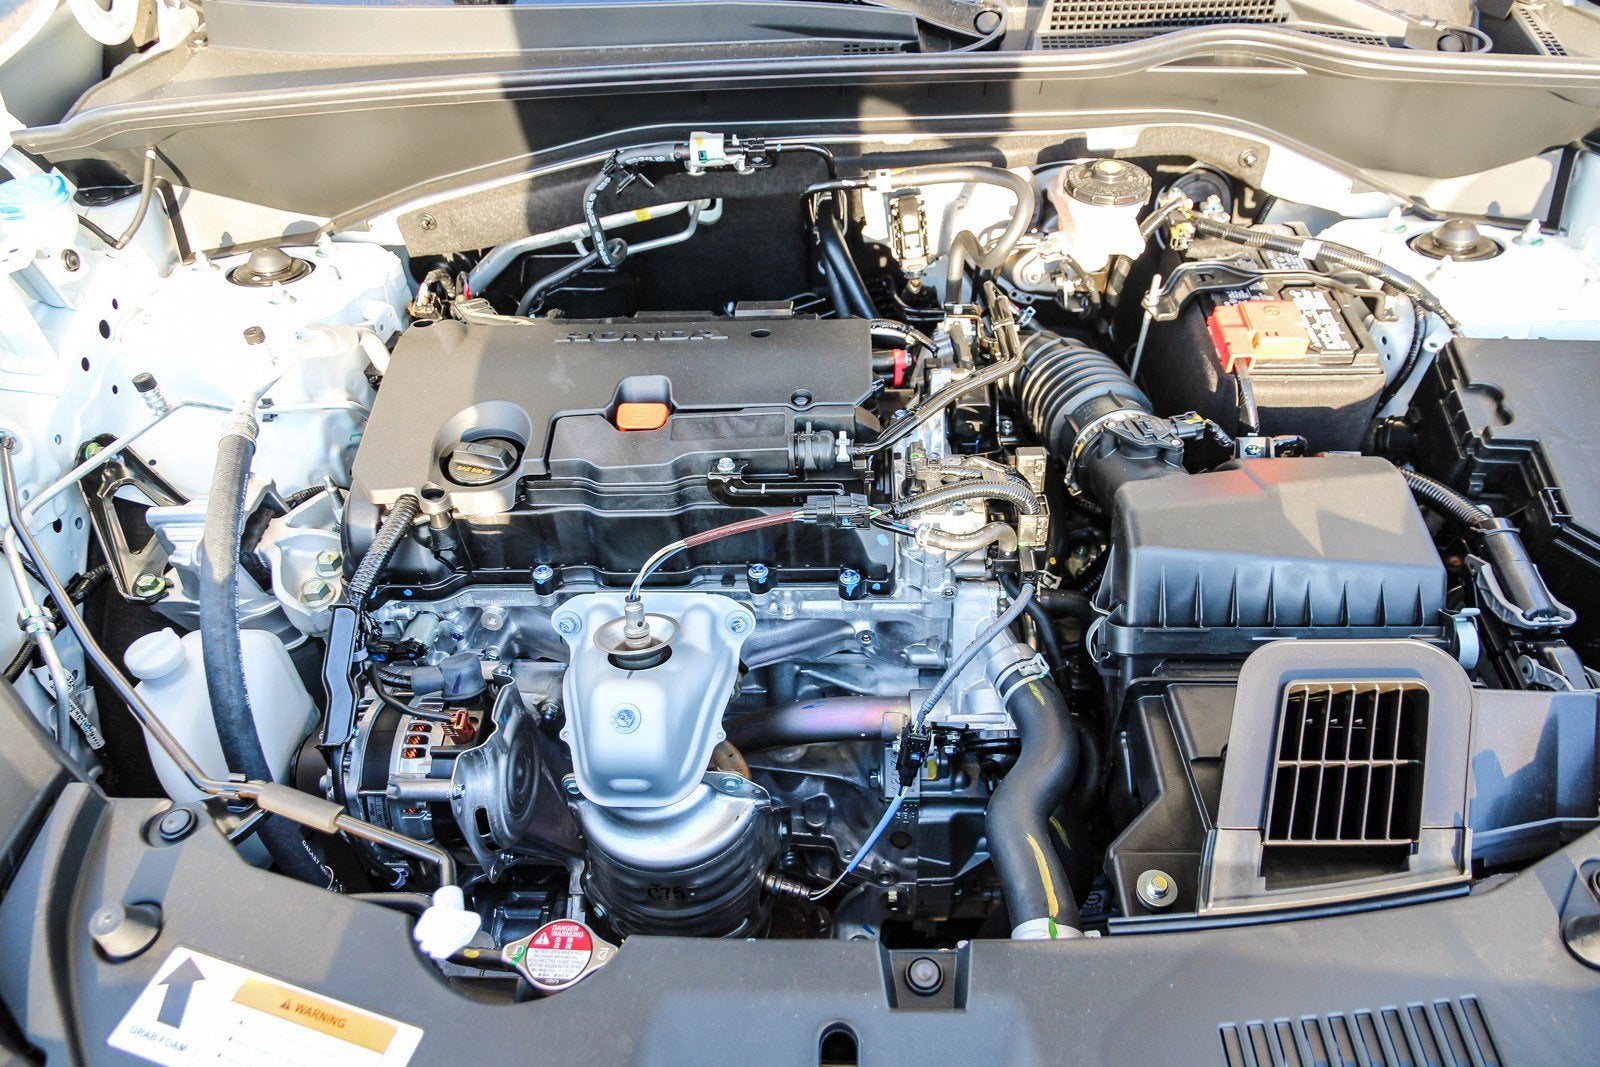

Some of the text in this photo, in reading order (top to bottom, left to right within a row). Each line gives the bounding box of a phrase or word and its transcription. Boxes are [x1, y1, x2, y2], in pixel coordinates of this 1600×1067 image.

[554, 329, 729, 344] HONDA
[551, 924, 580, 932] DANGER
[294, 1002, 348, 1029] WARNING
[129, 1025, 189, 1053] GRAB FOAM
